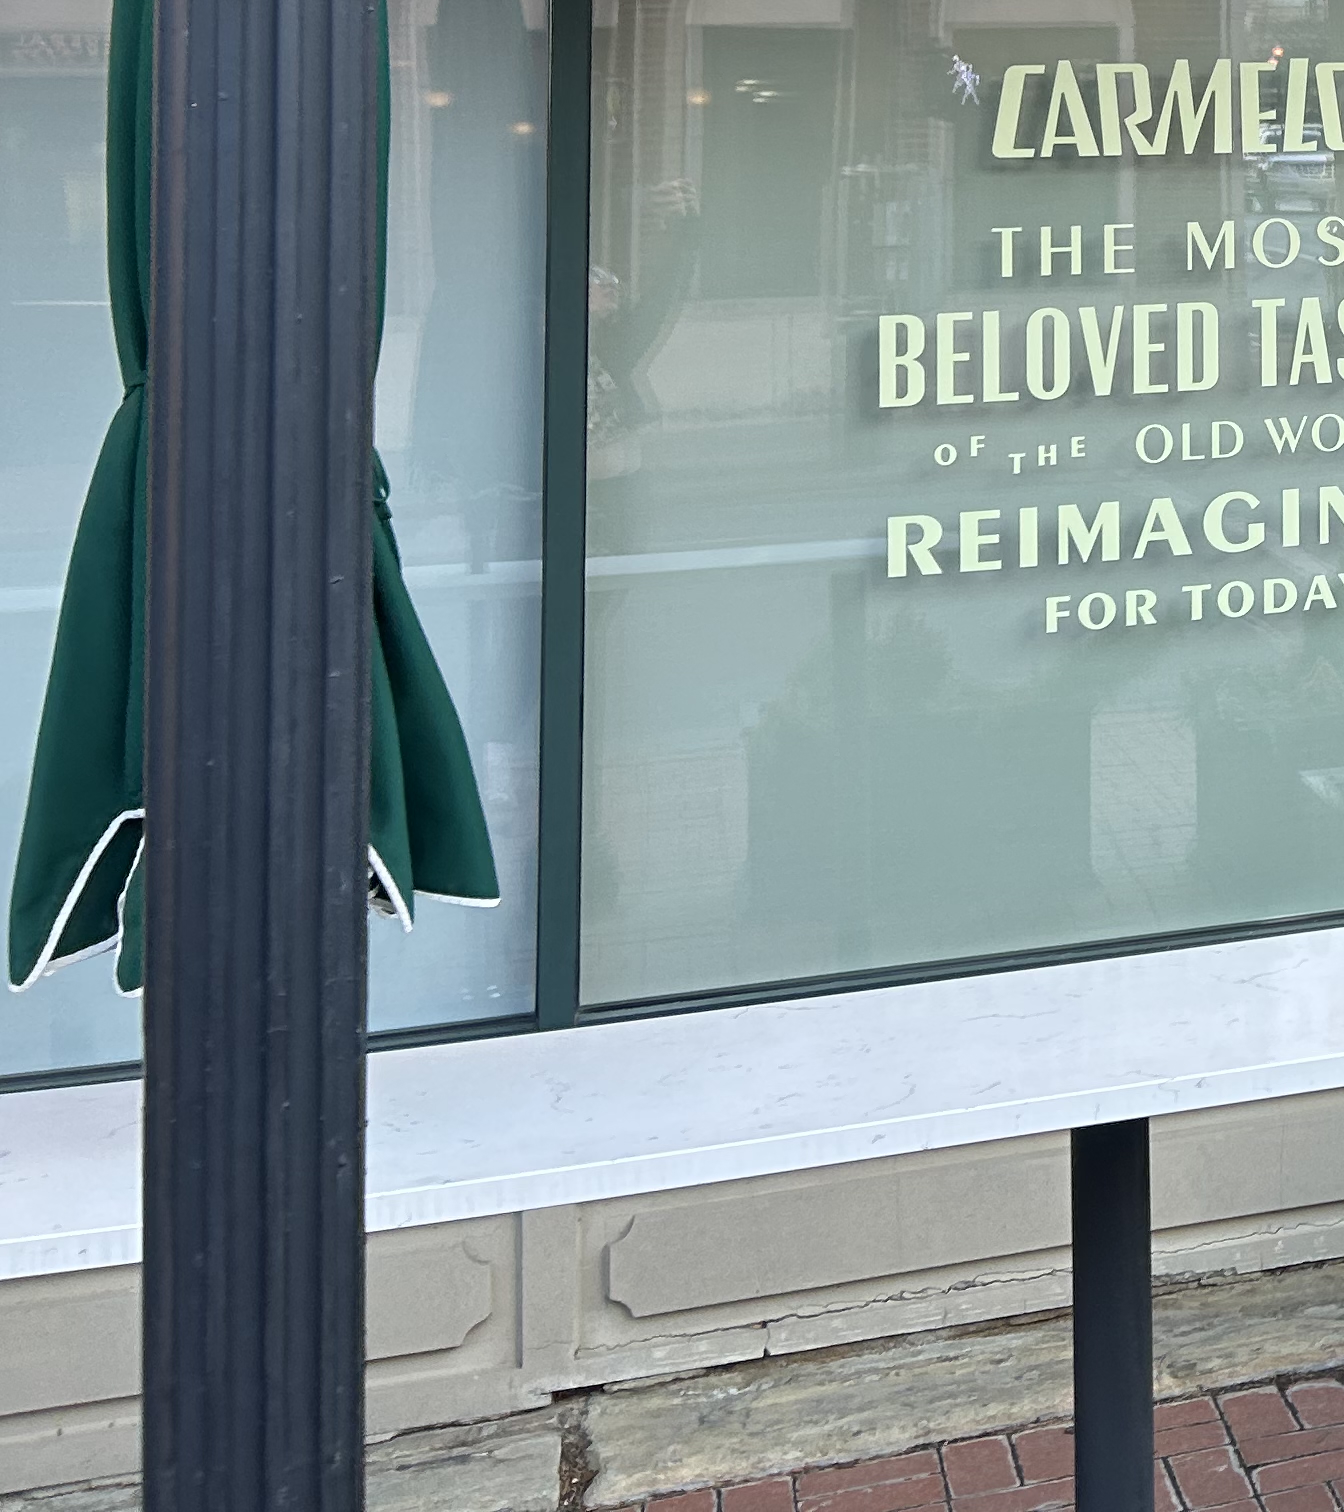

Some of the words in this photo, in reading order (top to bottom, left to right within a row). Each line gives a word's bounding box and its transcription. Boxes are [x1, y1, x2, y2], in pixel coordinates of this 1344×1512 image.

[991, 223, 1136, 278] THE
[878, 302, 1220, 409] BELOVED
[934, 434, 986, 467] OF
[1008, 435, 1087, 475] THE
[1135, 420, 1244, 464] OLD
[1045, 588, 1157, 634] FOR
